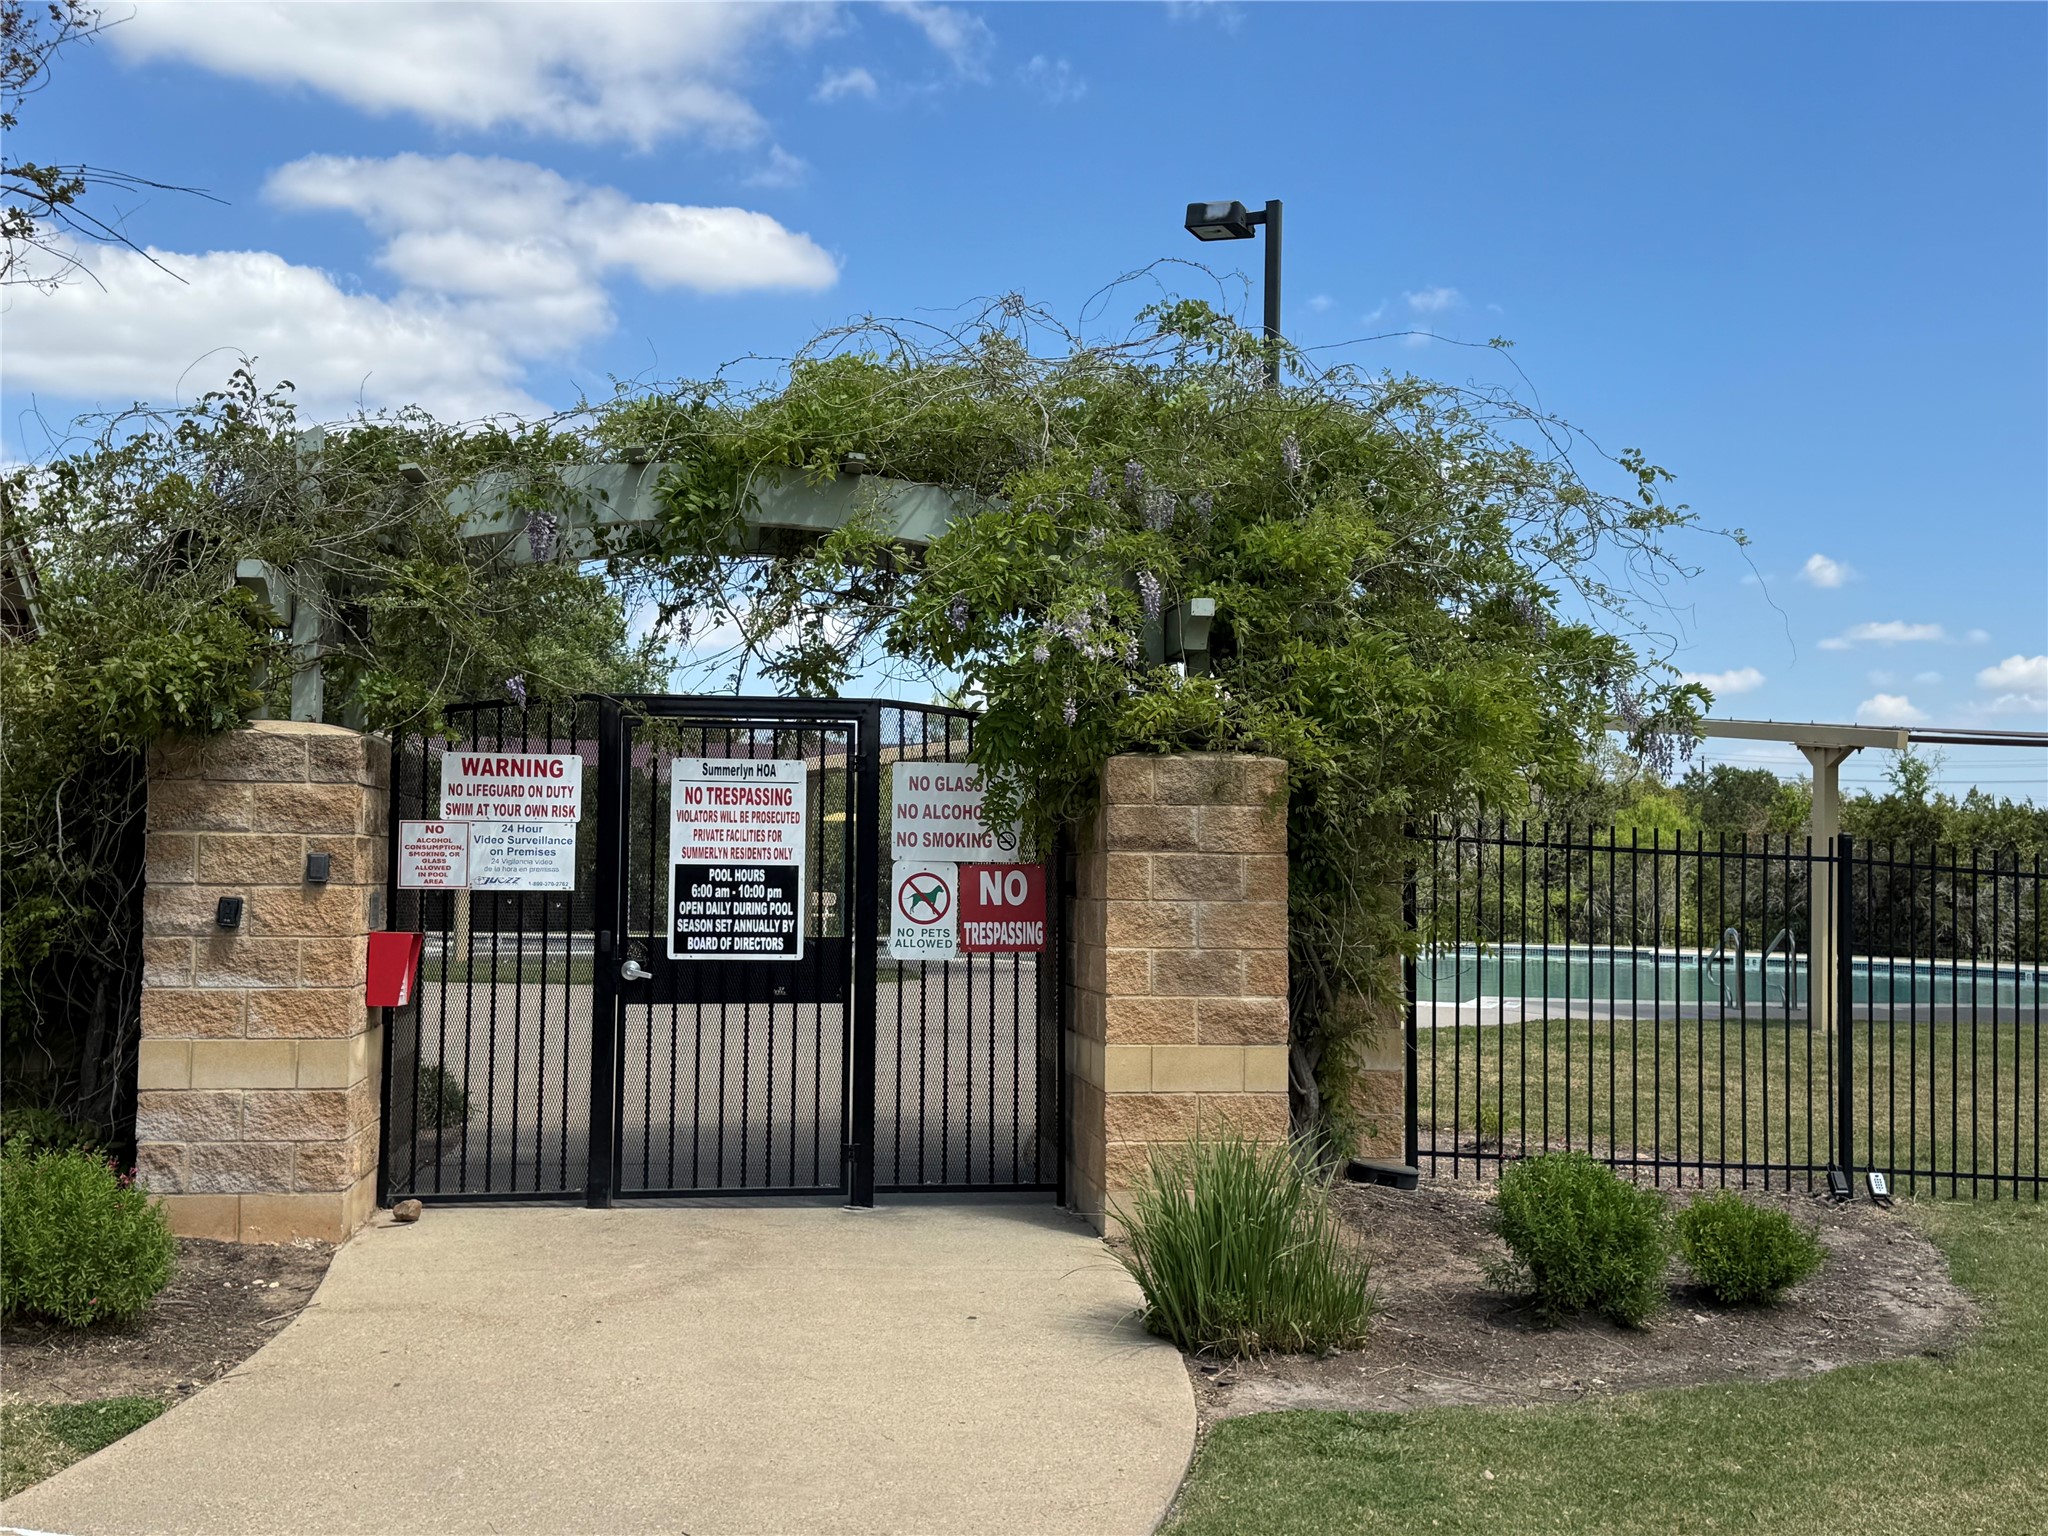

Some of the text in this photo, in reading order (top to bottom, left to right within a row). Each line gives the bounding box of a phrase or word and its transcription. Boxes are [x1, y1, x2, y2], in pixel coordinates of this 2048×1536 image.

[462, 758, 564, 778] WARNING
[702, 762, 777, 780] Summerlyn HOA
[909, 775, 930, 791] NO
[448, 783, 574, 799] NO LIFEGUARD ON DUTY
[685, 786, 792, 806] NO TRESPASSING
[445, 803, 576, 818] SWIM AT YOUR OWN RISK
[676, 810, 801, 824] VIOLATORS WILL BE PROSECUTED
[897, 803, 983, 820] NO ALCOHO
[425, 825, 444, 834] NO
[502, 824, 543, 833] 24 Hour
[693, 828, 782, 842] PRIVATE FACILITIES FOR
[474, 835, 573, 845] Video Surveillance
[897, 831, 992, 848] NO SMOKING
[490, 847, 556, 856] on Premises
[681, 846, 793, 860] SUMMERLYN RESIDENTS ONLY
[709, 869, 765, 882] POOL HOURS
[691, 884, 712, 898] 6:00
[715, 886, 730, 898] am
[738, 885, 765, 898] 10:00
[767, 887, 782, 901] pm
[979, 870, 1028, 906] NO
[679, 901, 793, 916] OPEN DAILY DURING POOL
[677, 919, 795, 933] SEASON SET ANNUALLY BY
[897, 928, 950, 938] NO PETS
[964, 921, 1043, 945] TRESPASSING
[687, 937, 784, 950] BOARD OF DIRECTORS
[895, 939, 953, 948] ALLOWED
